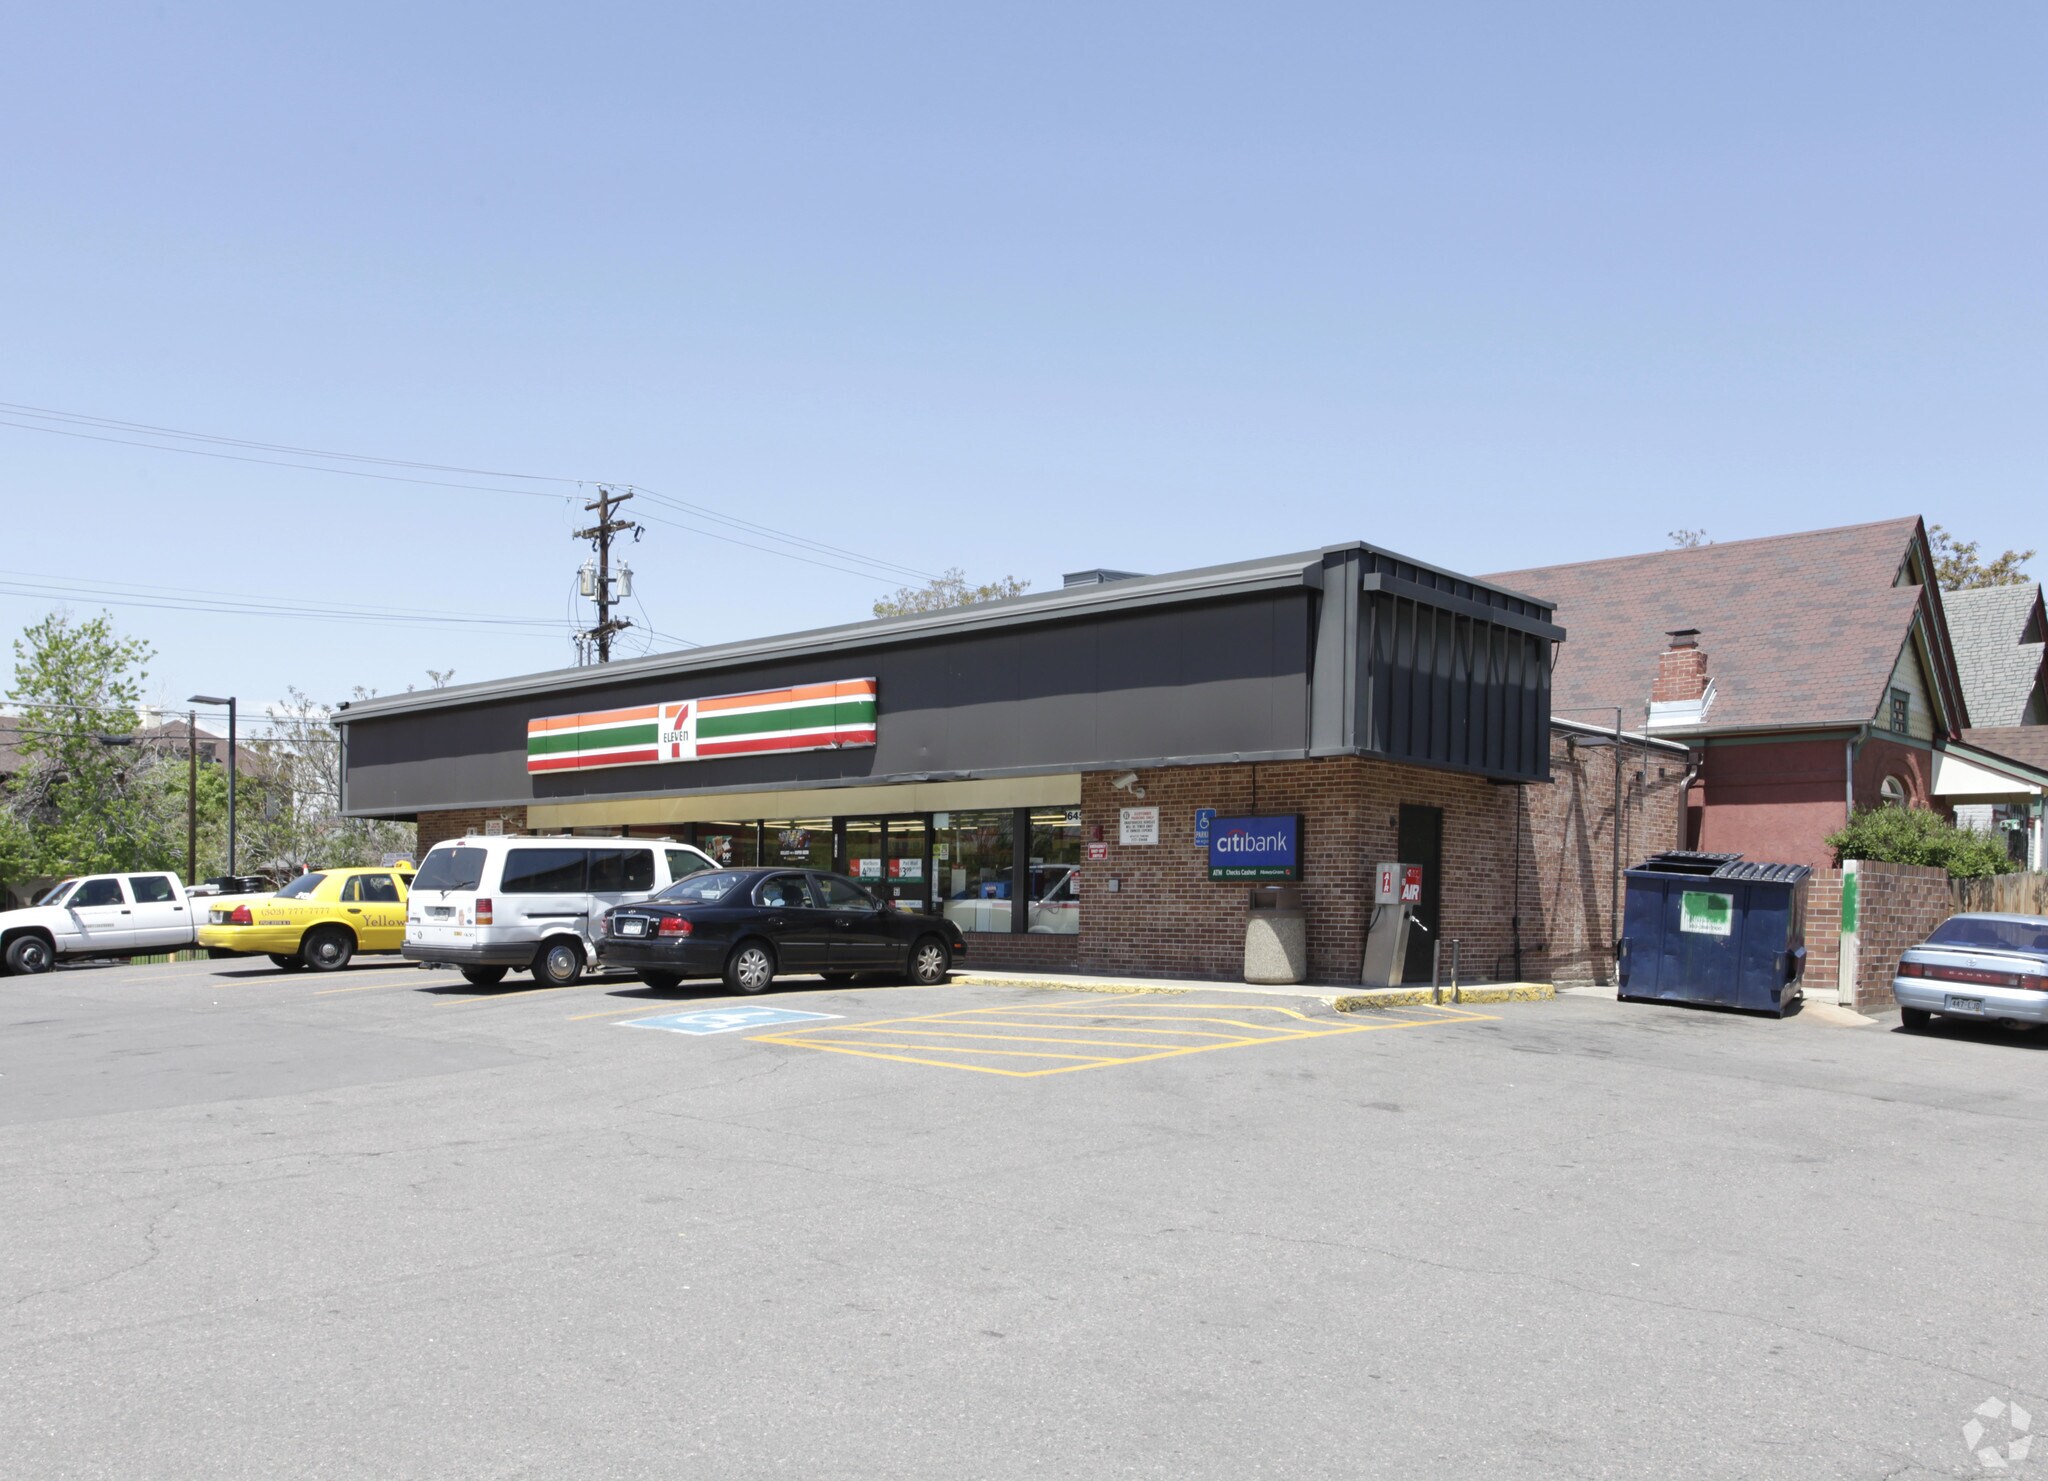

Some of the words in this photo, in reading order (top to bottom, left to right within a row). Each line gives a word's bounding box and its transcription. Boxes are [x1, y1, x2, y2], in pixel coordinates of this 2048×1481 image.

[665, 704, 689, 758] 7
[1217, 831, 1287, 852] citibank
[1401, 884, 1420, 900] AIR
[1949, 970, 1991, 979] CAMRY
